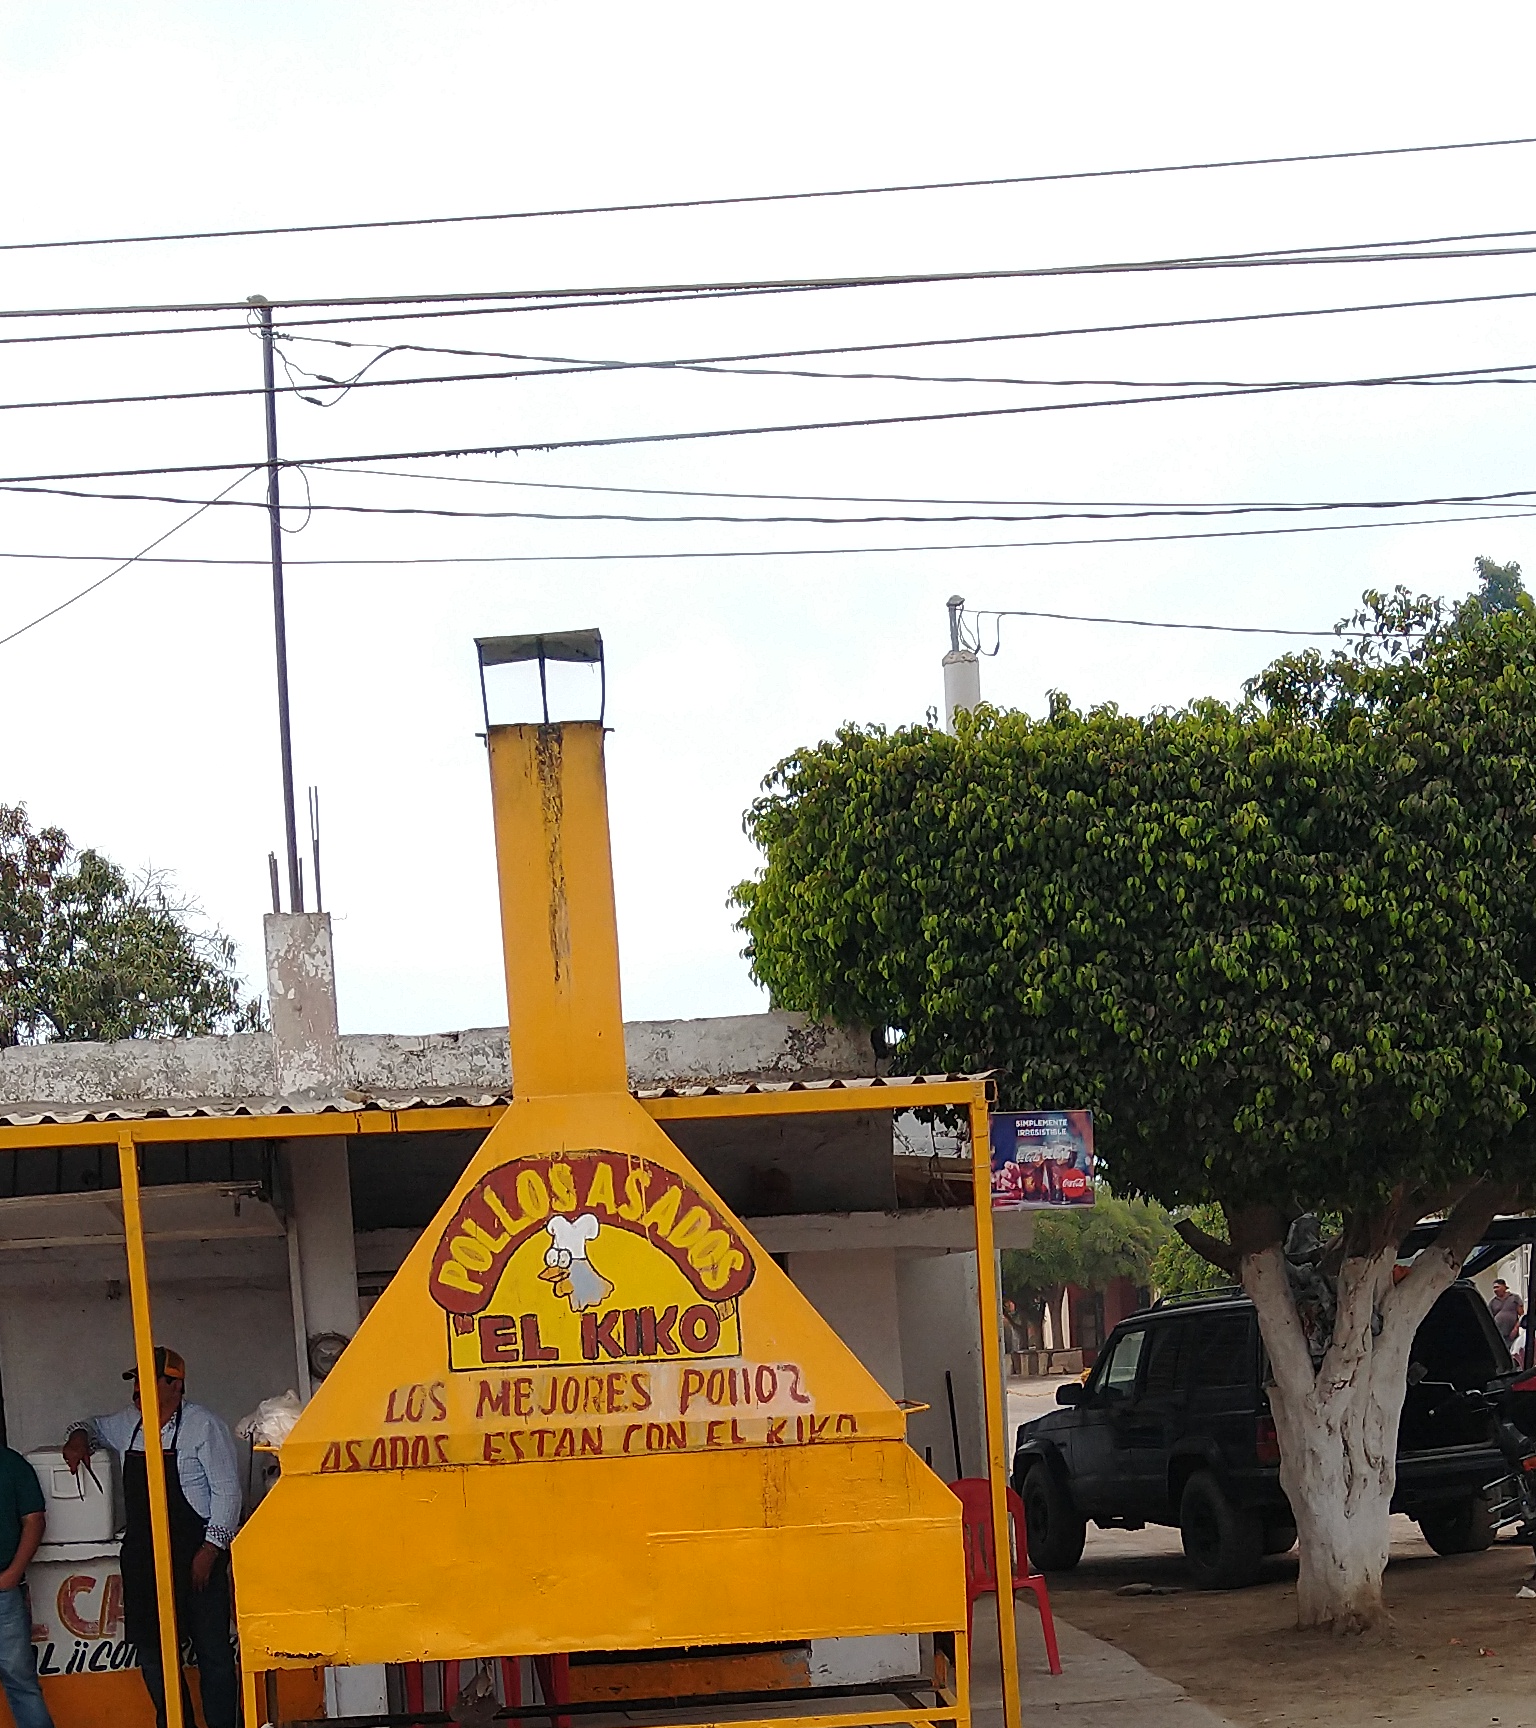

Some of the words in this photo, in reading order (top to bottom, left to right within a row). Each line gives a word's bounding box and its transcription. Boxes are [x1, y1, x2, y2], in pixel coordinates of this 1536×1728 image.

[1015, 1118, 1068, 1127] SIMPLEMENTE
[1017, 1128, 1067, 1137] IRRESISTIBLE
[438, 1162, 577, 1295] POLLOS
[585, 1162, 745, 1291] ASADOS
[384, 1380, 448, 1423] LOS
[476, 1372, 654, 1420] MEJORES
[482, 1425, 603, 1465] ESTAN
[707, 1417, 746, 1446] EL
